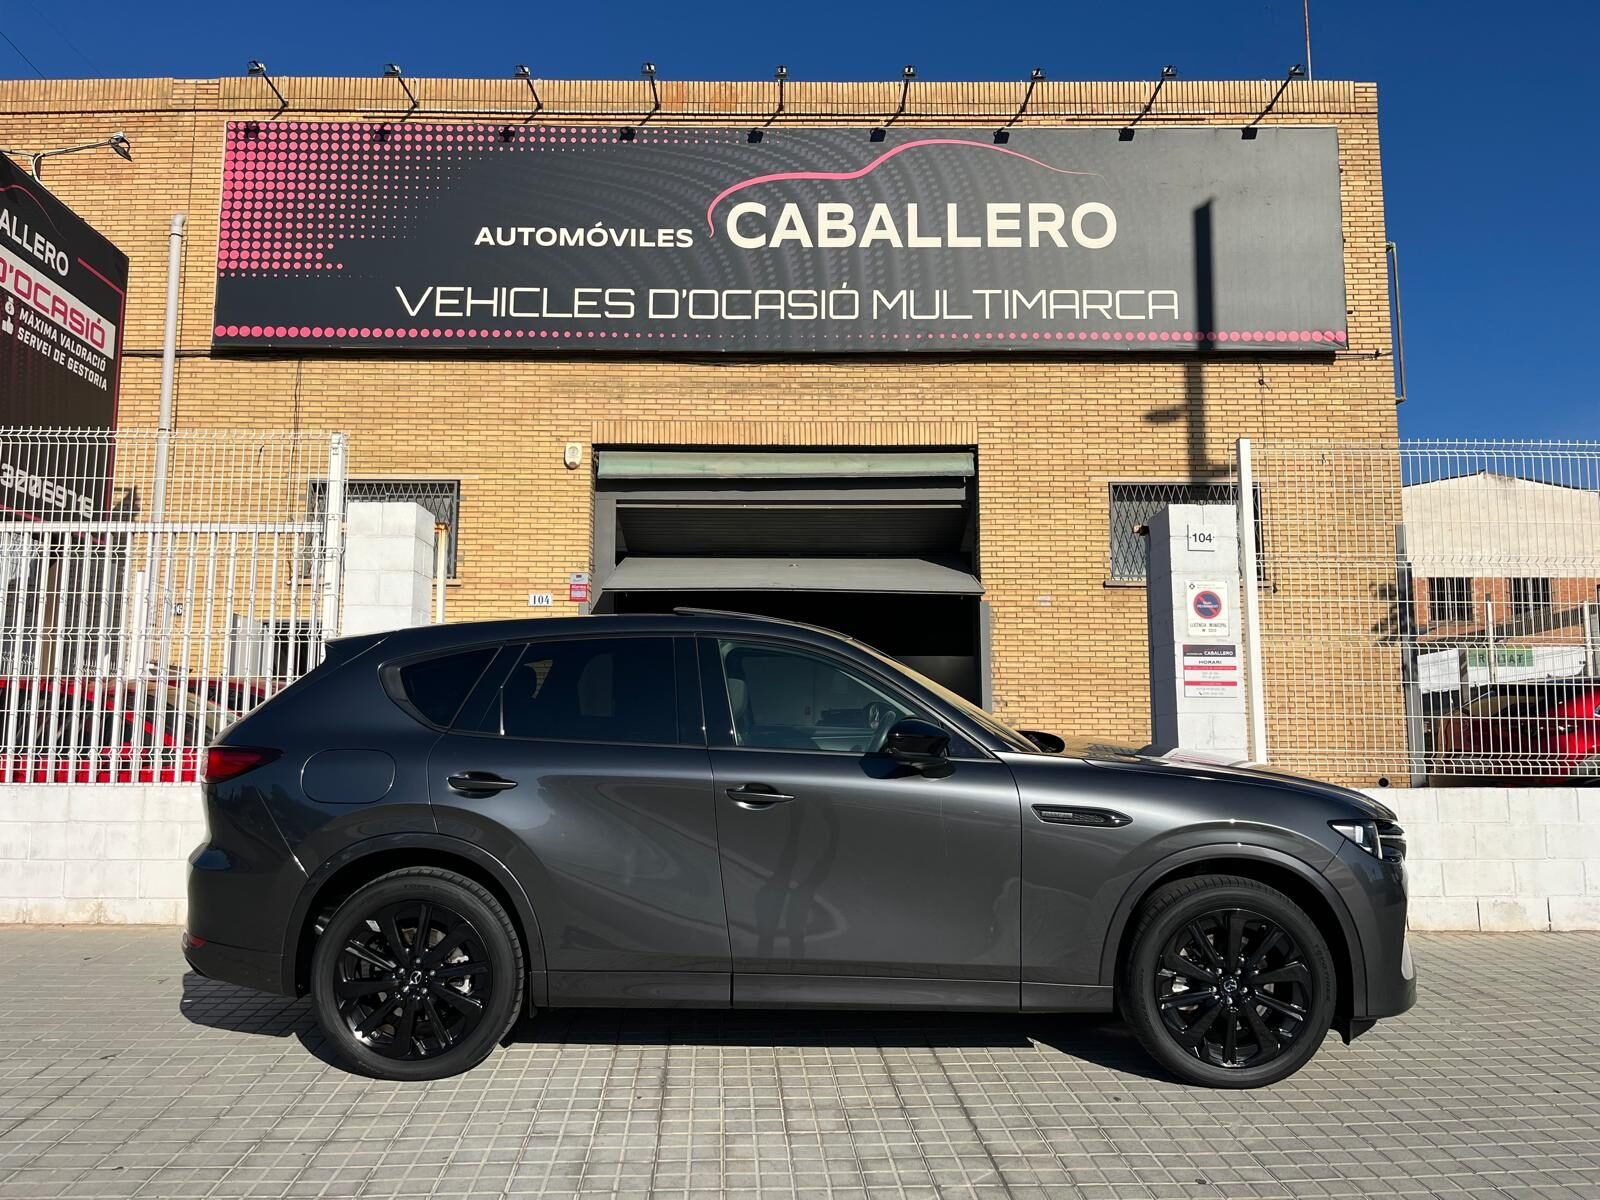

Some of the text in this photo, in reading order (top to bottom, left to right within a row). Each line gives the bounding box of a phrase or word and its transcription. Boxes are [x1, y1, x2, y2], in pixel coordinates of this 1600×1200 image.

[474, 201, 1118, 250] AUTOMÓVILES CABALLERO
[395, 282, 1179, 320] VEHICLES D'OCASIÓ MULTIMARCA
[17, 329, 107, 391] SERVEI DE GESTORIA
[19, 307, 107, 372] MÀXIMA VALORACIÓ
[1191, 532, 1213, 544] 104
[533, 594, 550, 605] 104
